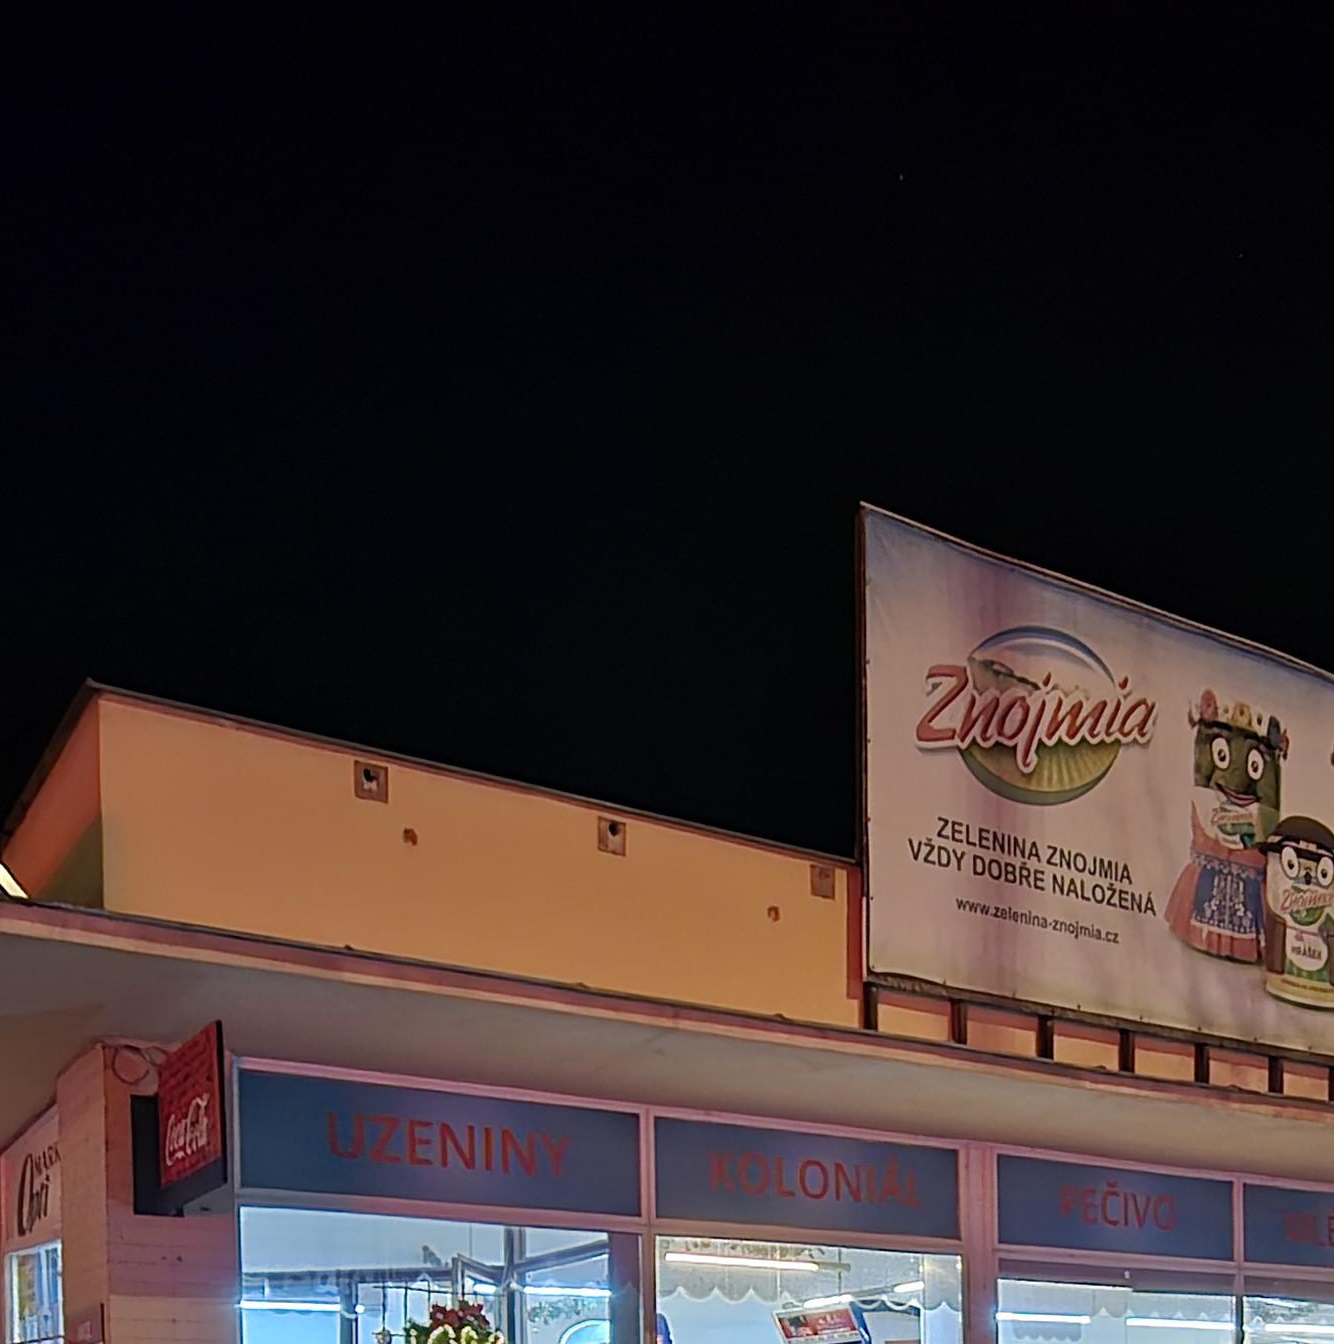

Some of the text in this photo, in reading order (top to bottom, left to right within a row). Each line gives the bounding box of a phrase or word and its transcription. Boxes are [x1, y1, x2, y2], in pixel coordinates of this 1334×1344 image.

[916, 664, 1157, 769] Znojmia
[907, 837, 1158, 917] VŽDY DOBŘE NALOŽENÁ
[936, 816, 1134, 886] ZELENINA ZNOJMIA
[955, 897, 1120, 945] www.zelenina-znojmia.cz
[327, 1109, 572, 1179] UZENINY
[708, 1150, 923, 1211] KOLONIÁL
[1059, 1179, 1179, 1232] PEČIVO
